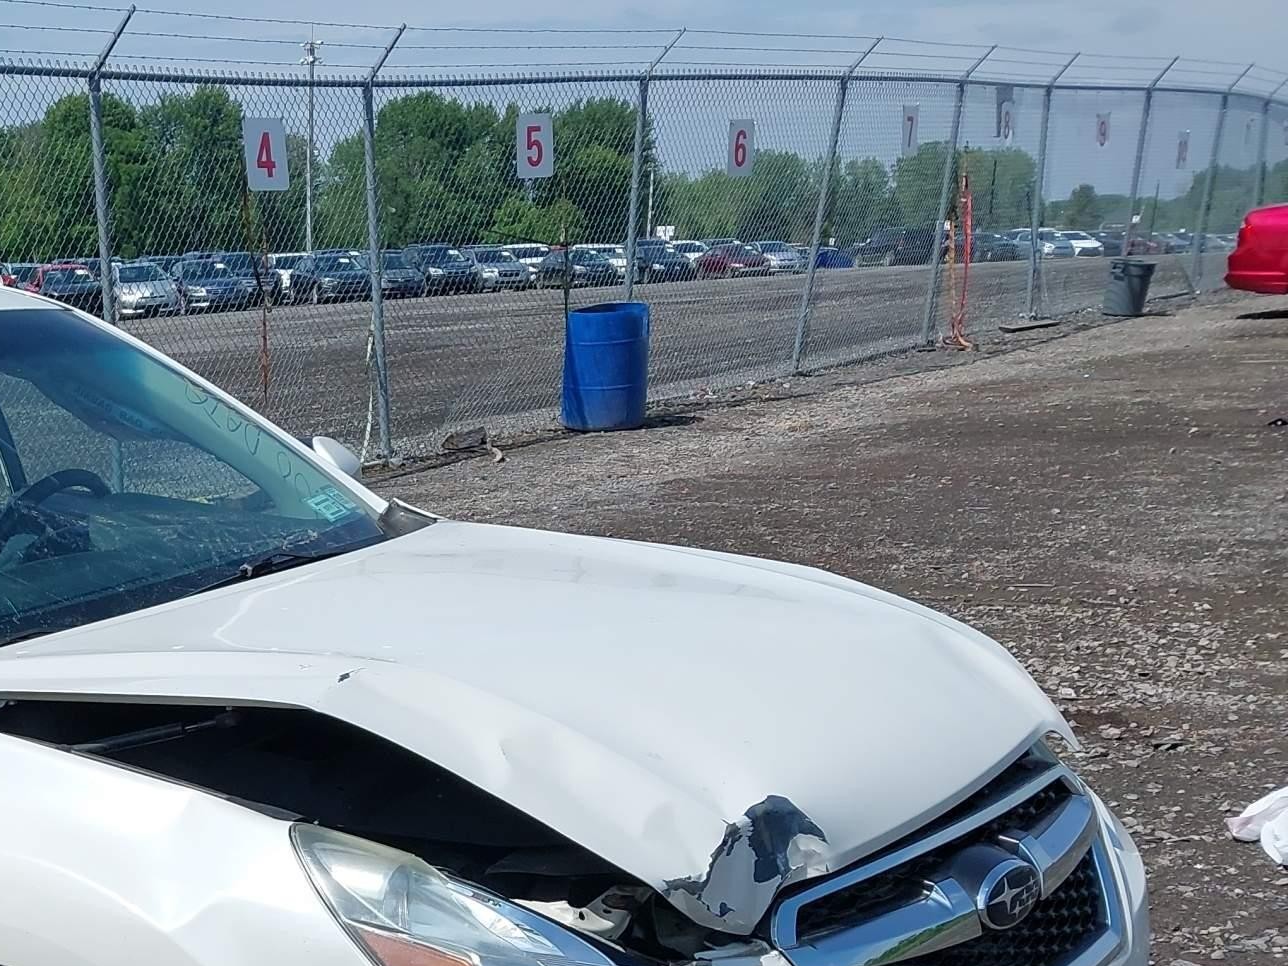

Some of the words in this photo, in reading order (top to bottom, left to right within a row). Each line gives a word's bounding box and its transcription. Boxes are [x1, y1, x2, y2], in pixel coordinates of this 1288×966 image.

[906, 115, 915, 148] 7
[1003, 110, 1011, 140] 8
[257, 132, 276, 178] 4
[527, 125, 543, 167] 5
[734, 129, 747, 168] 6
